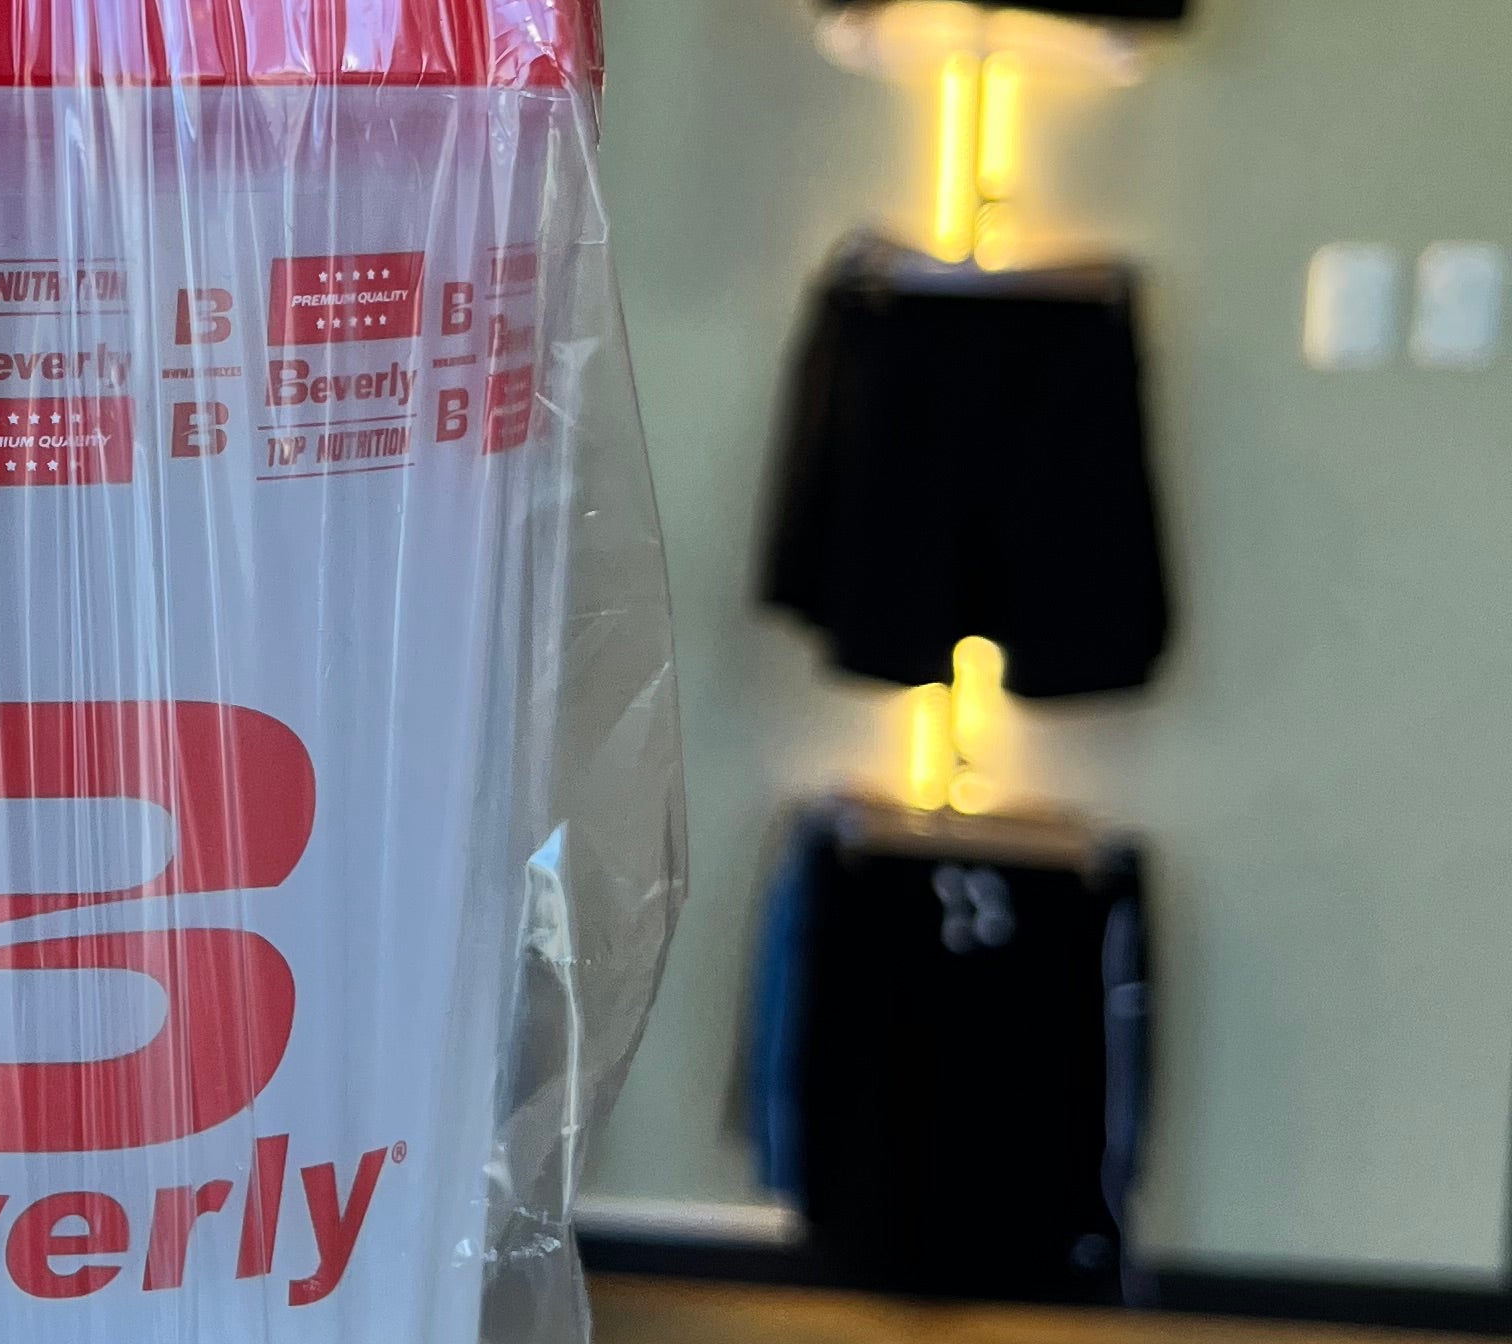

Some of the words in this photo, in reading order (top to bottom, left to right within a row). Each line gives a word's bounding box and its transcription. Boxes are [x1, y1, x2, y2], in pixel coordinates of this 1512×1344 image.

[174, 287, 233, 345] B
[291, 292, 356, 307] PREMIUM
[358, 289, 409, 305] QUALITY
[265, 359, 417, 406] Beverly
[171, 401, 230, 458] B
[268, 436, 306, 467] TOP
